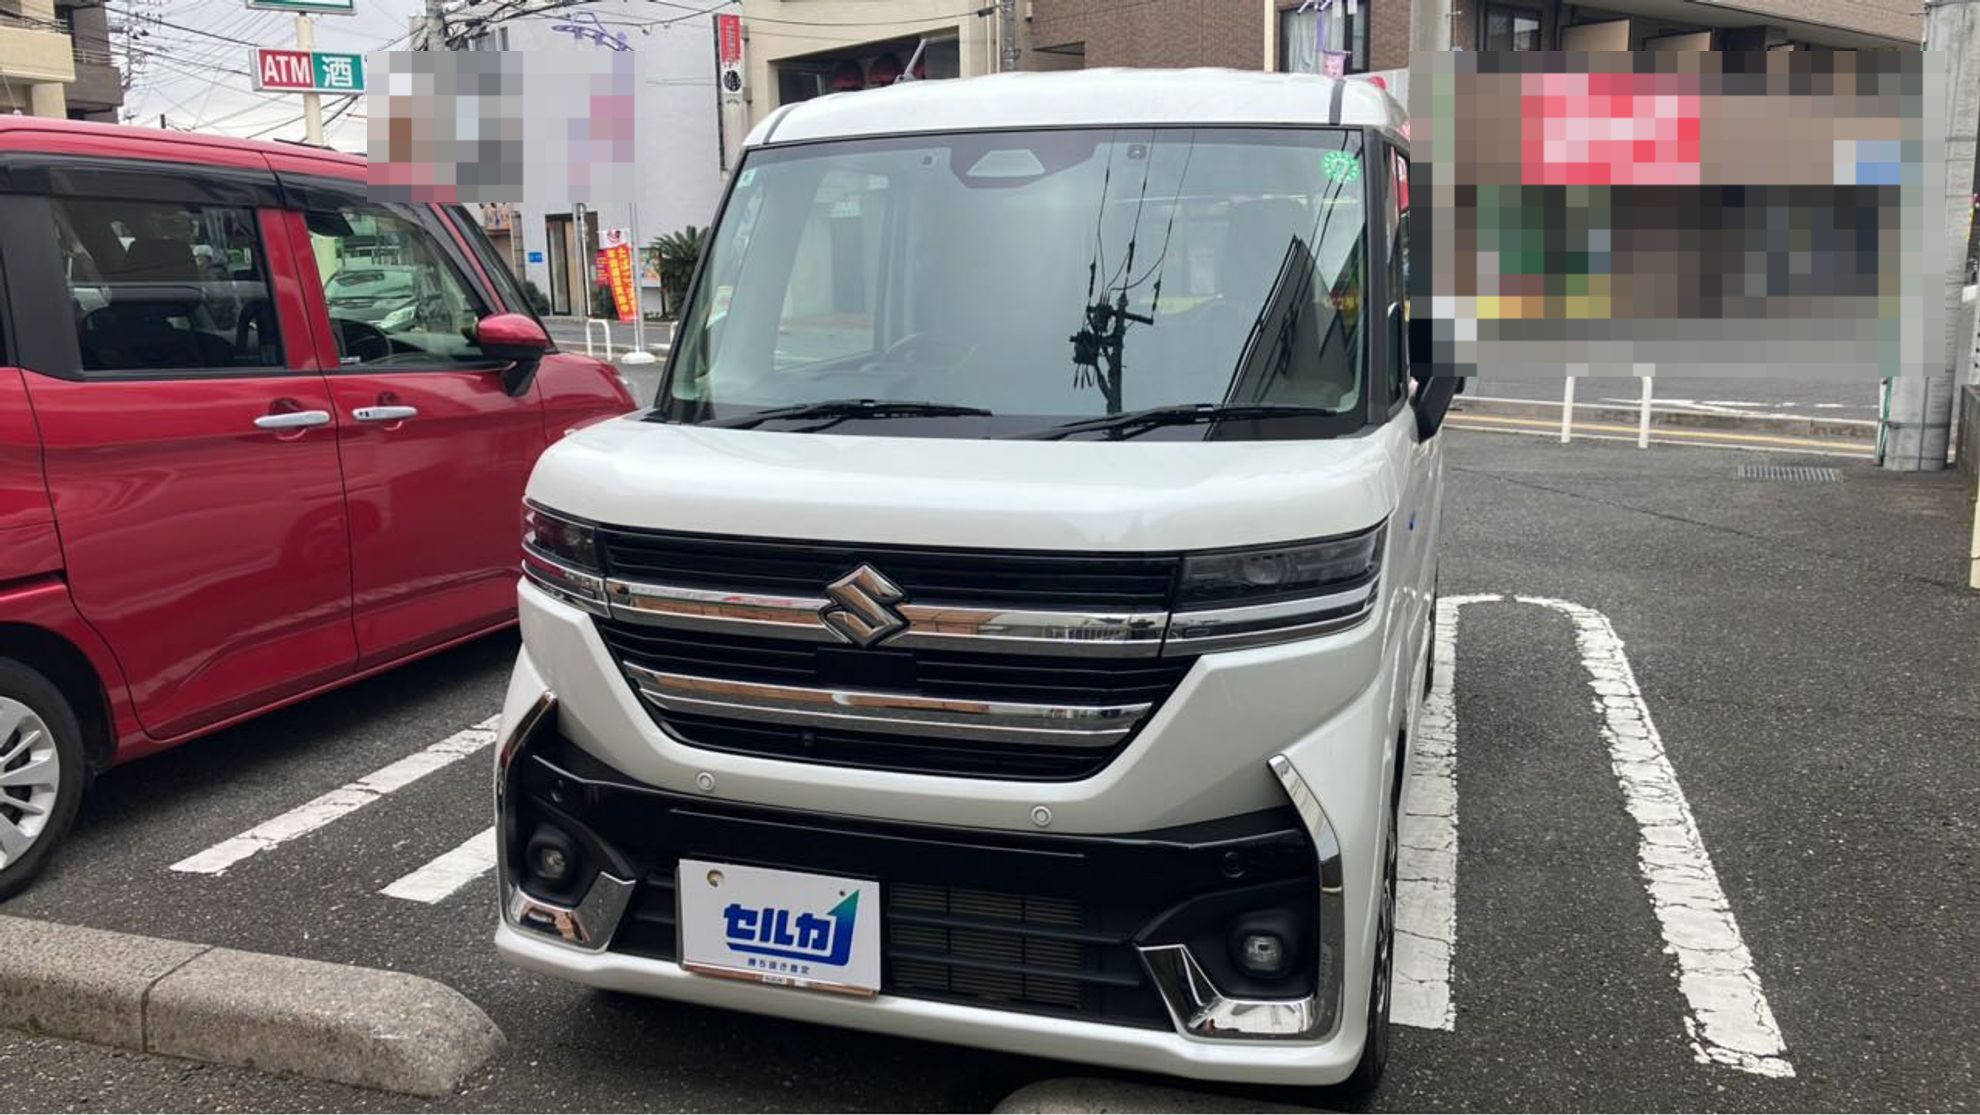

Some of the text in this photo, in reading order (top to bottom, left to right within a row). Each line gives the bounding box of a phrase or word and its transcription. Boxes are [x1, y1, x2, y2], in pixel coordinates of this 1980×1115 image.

[264, 55, 311, 84] ATM
[321, 56, 353, 87] 酒
[723, 903, 832, 951] セルカ
